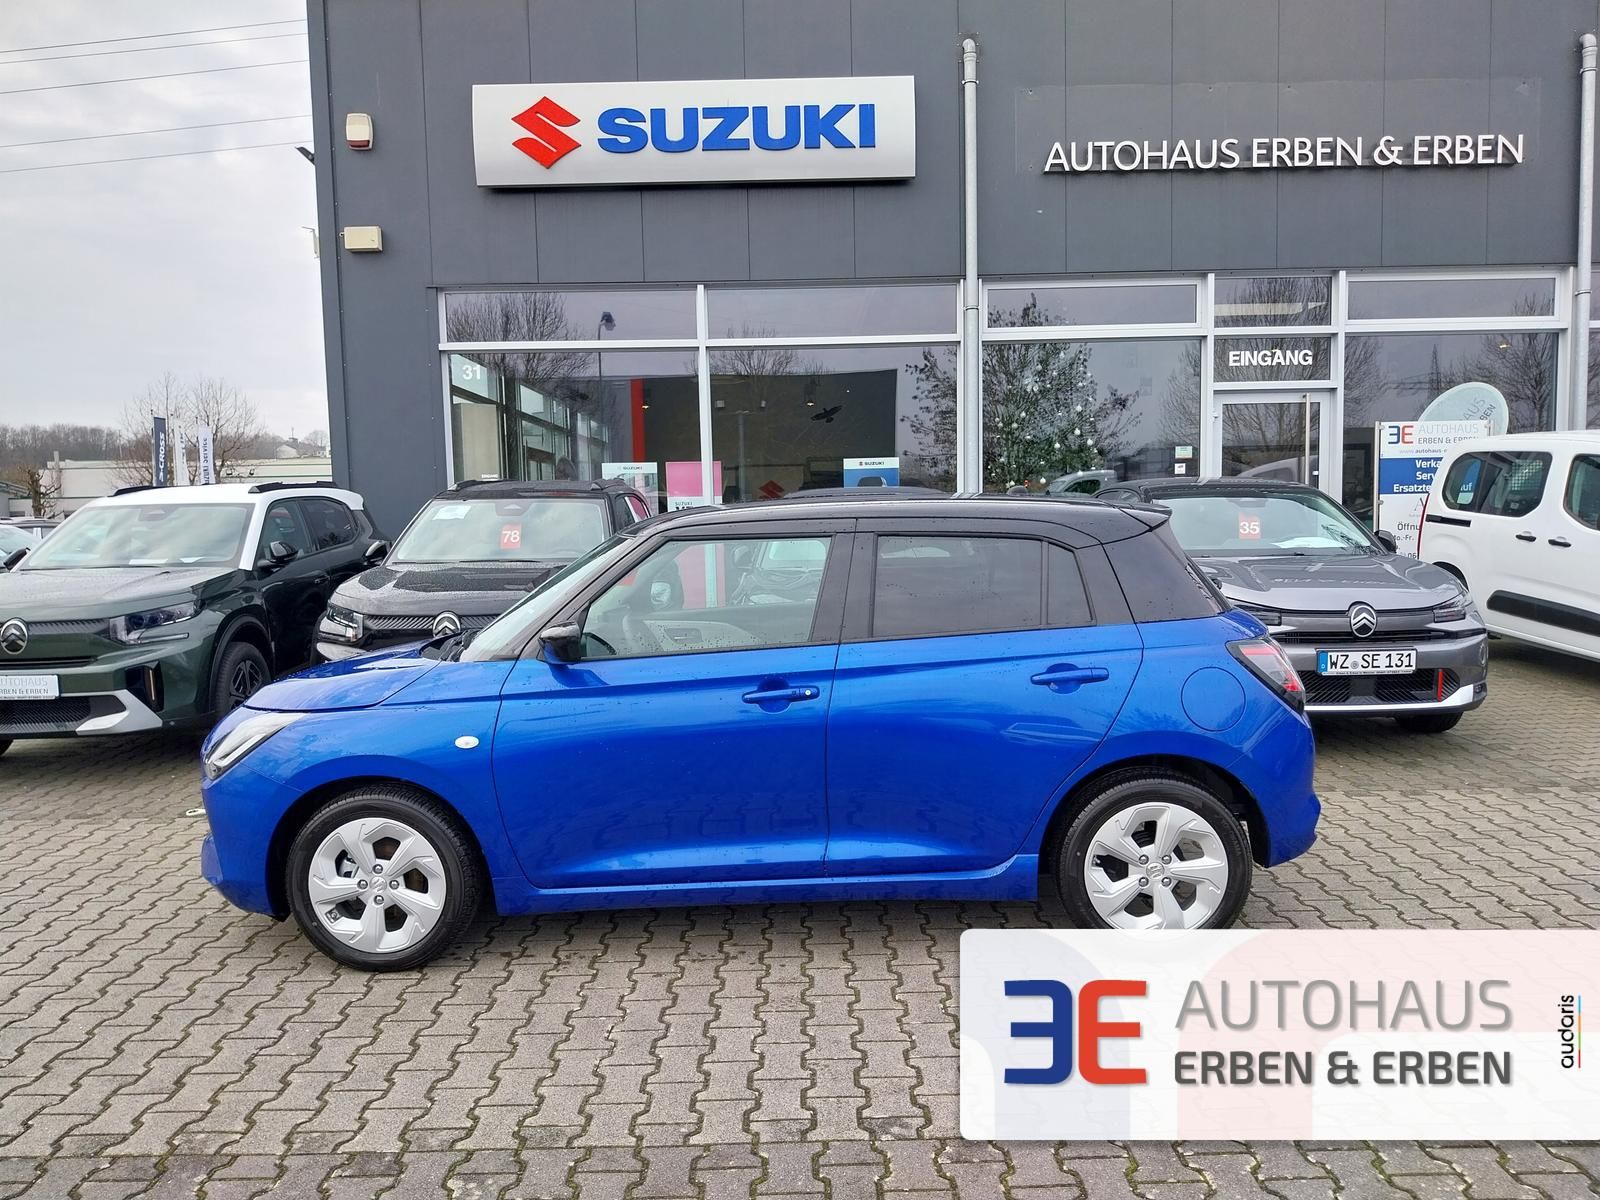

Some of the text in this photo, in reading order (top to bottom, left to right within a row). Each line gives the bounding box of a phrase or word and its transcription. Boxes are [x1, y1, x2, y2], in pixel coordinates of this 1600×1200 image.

[597, 103, 876, 153] SUZUKI
[1044, 134, 1524, 172] AUTOHAUS ERBEN & ERBEN
[1229, 349, 1313, 366] EINGANG
[462, 364, 481, 381] 31
[1418, 423, 1479, 435] AUTOHAUS
[1418, 437, 1444, 445] ERBEN
[1240, 521, 1260, 535] 35
[502, 530, 520, 544] 78
[1329, 654, 1349, 669] WZ
[1361, 653, 1381, 669] SE
[1385, 652, 1413, 668] 131
[0, 677, 48, 687] UTOHAUS
